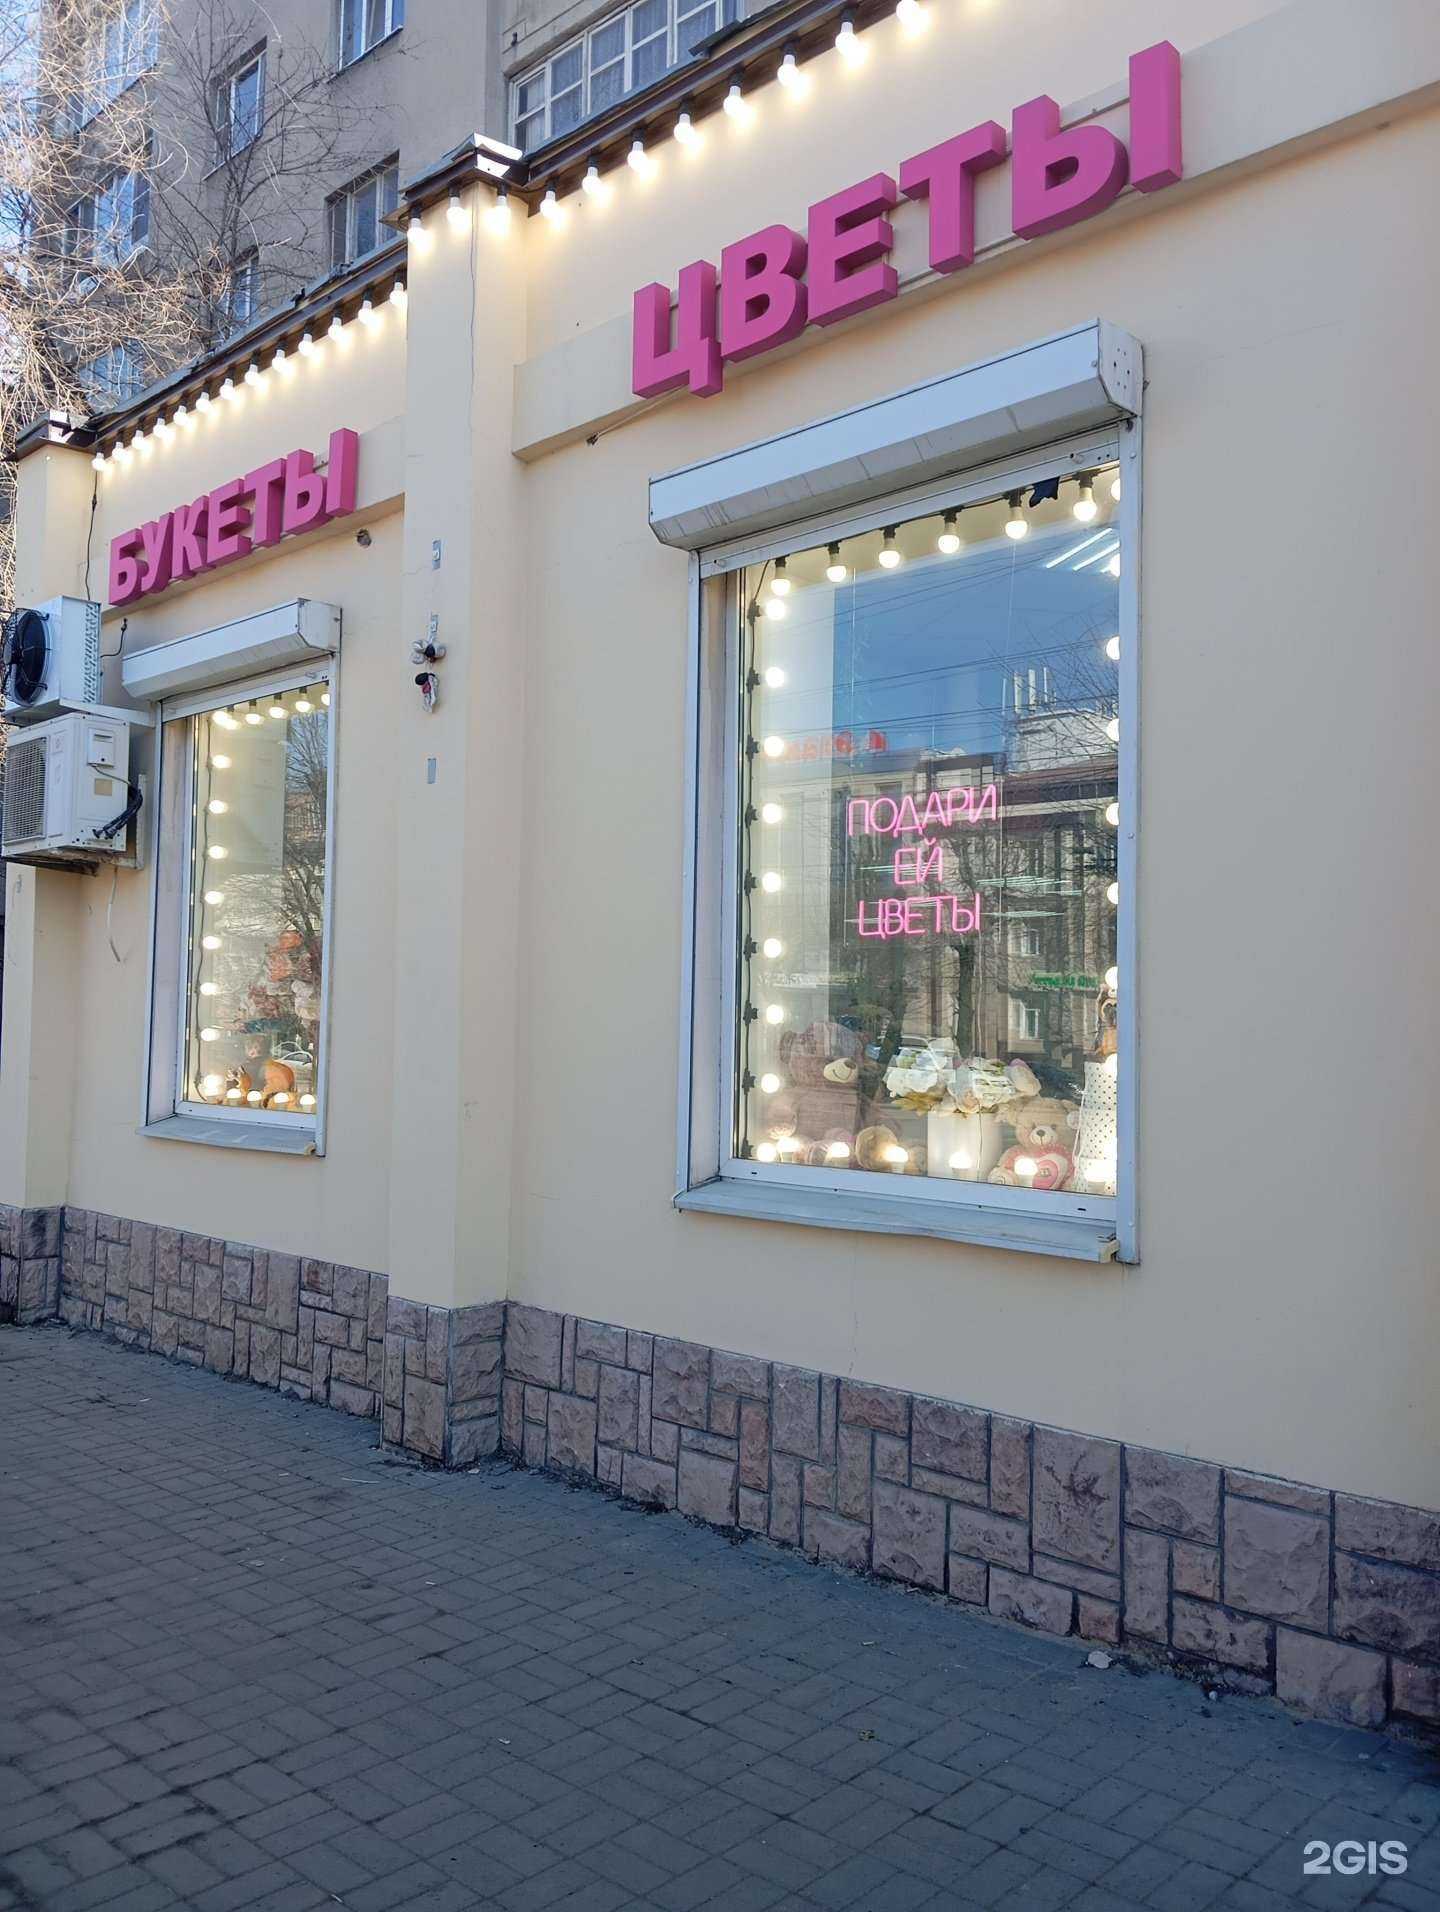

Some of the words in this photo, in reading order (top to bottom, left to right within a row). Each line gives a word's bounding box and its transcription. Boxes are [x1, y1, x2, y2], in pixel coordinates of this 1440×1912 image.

[632, 40, 1183, 400] ЦВЕТЫ
[109, 427, 359, 607] БУКЕТЫ
[847, 784, 998, 838] ПОДАРИ
[894, 837, 944, 886] ЕЙ
[858, 893, 981, 939] ЦВЕТЫ
